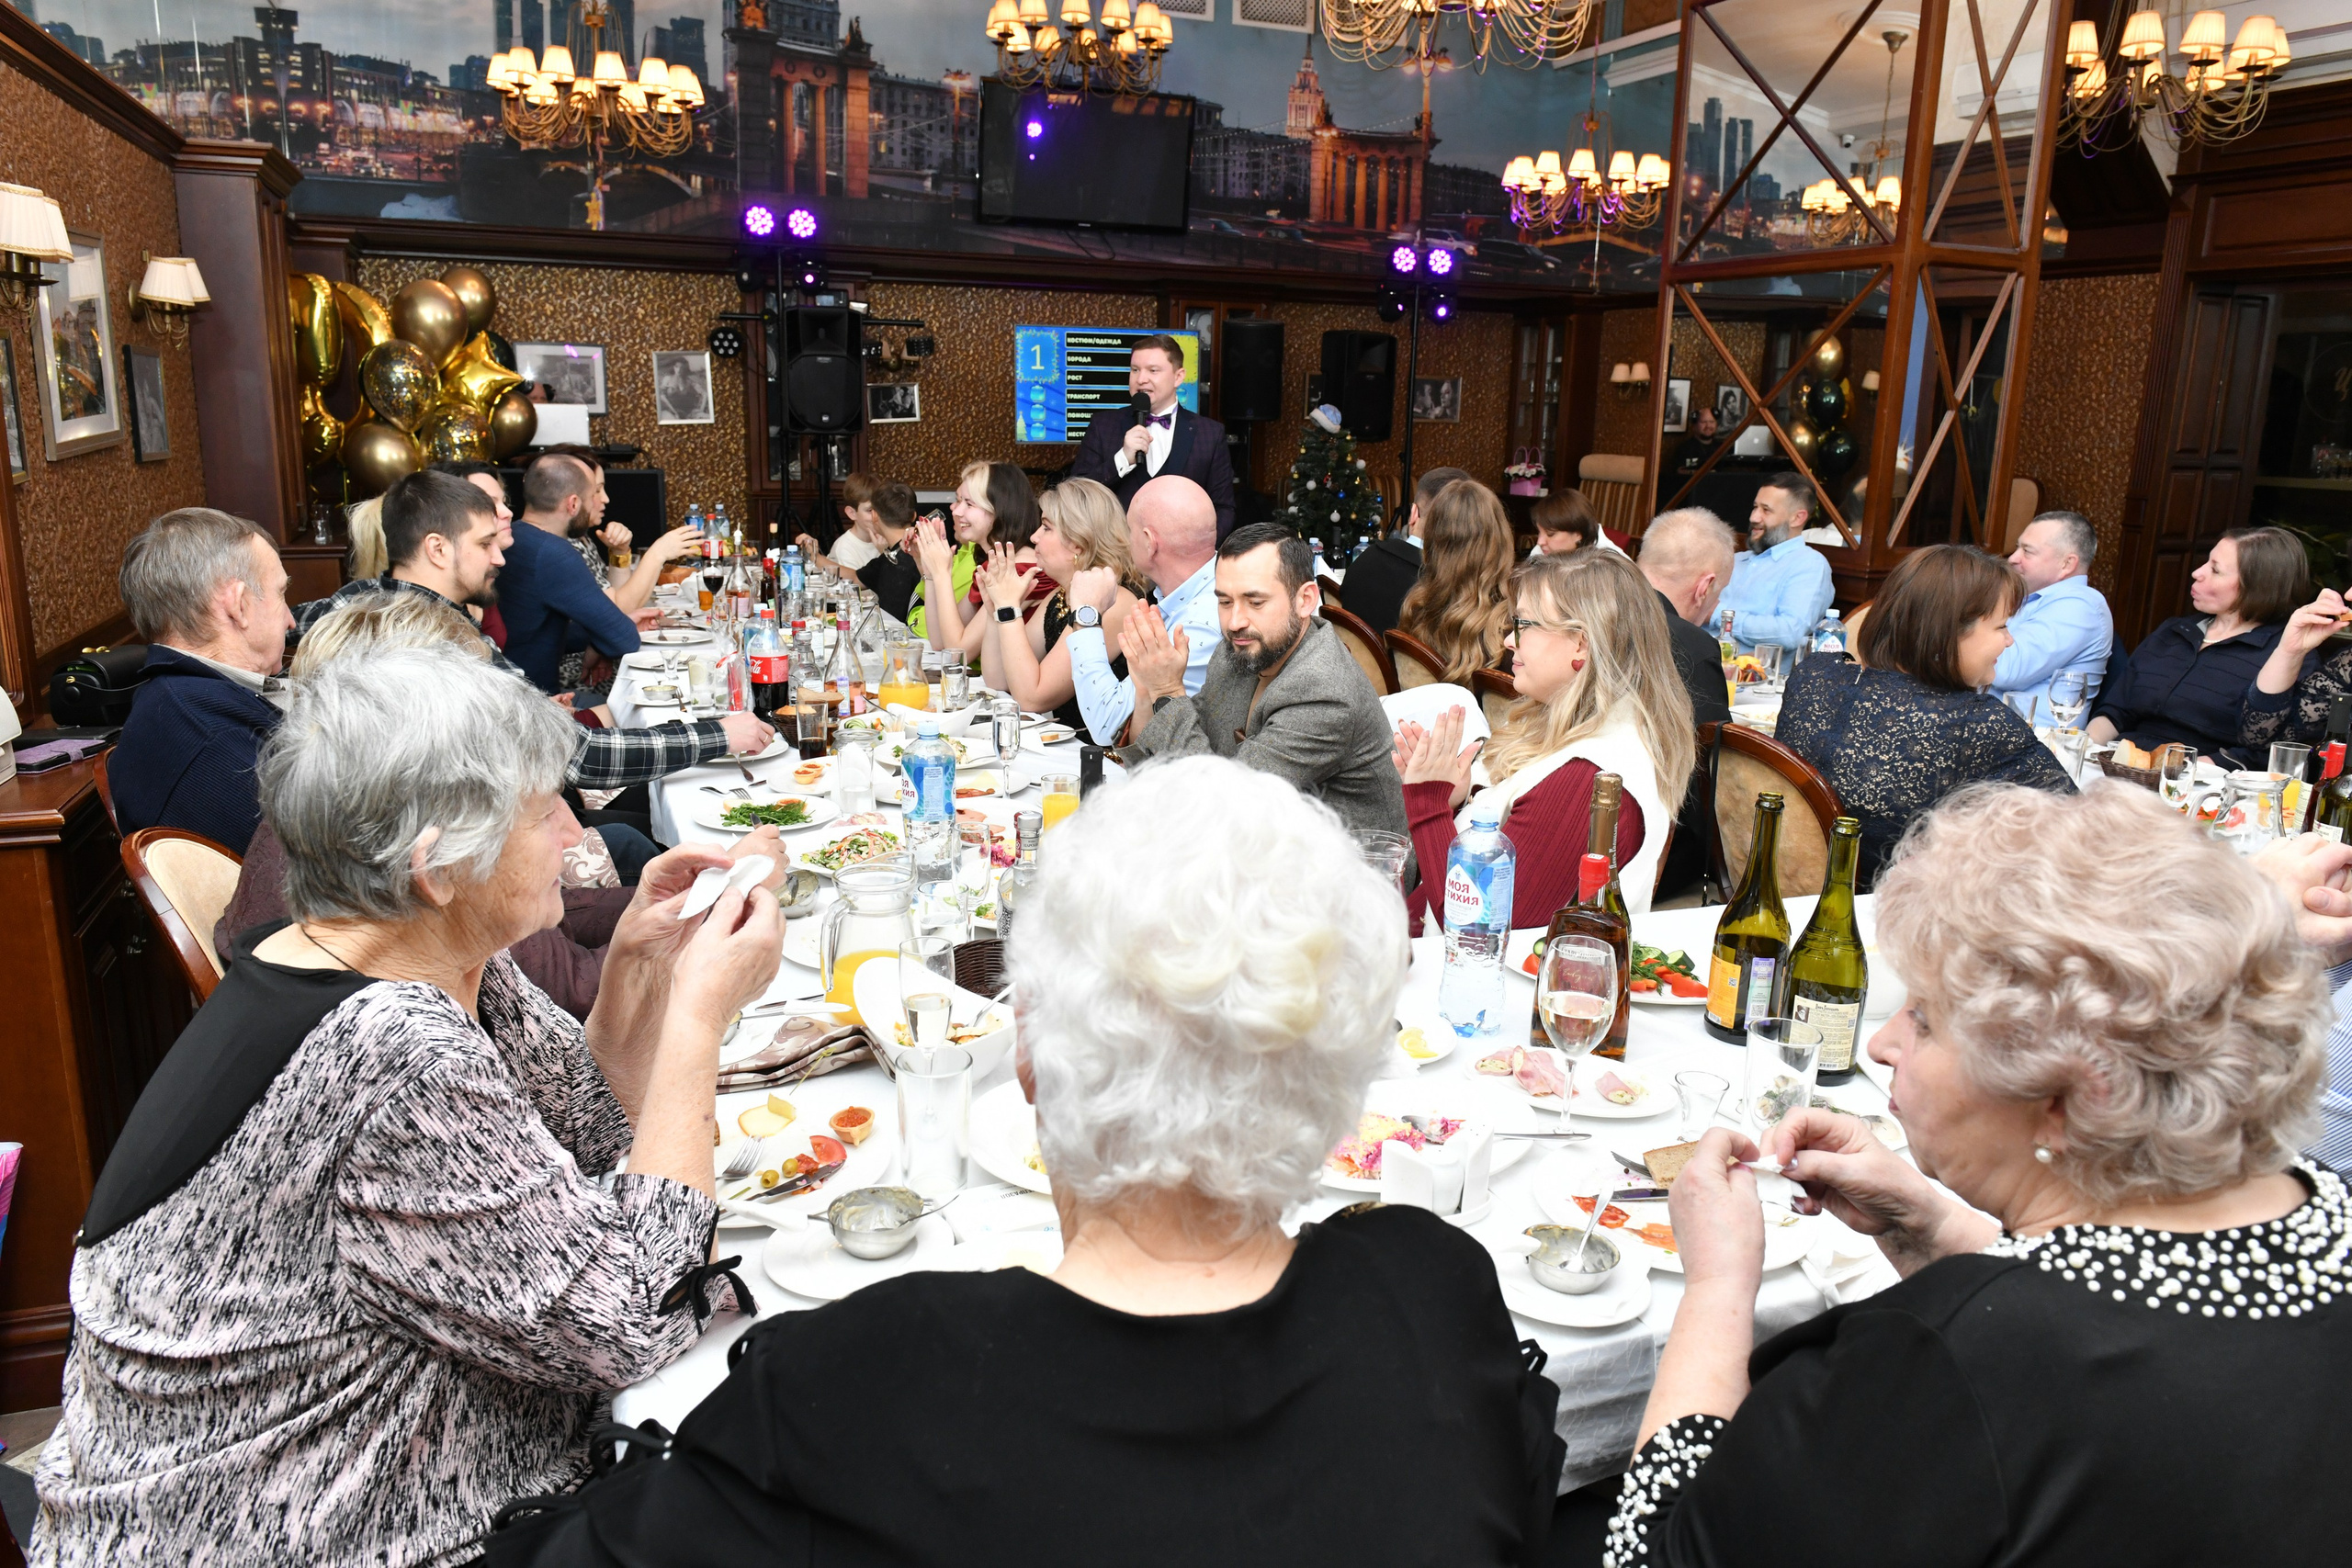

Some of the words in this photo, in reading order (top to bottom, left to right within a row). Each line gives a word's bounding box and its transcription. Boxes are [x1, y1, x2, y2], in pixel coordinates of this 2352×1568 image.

[1067, 337, 1122, 345] КОСТЮМ/ОДЕЖДА
[1031, 344, 1045, 370] 1
[1448, 877, 1470, 894] МОЯ
[1000, 1189, 1035, 1200] ЕПРАЗОЛ
